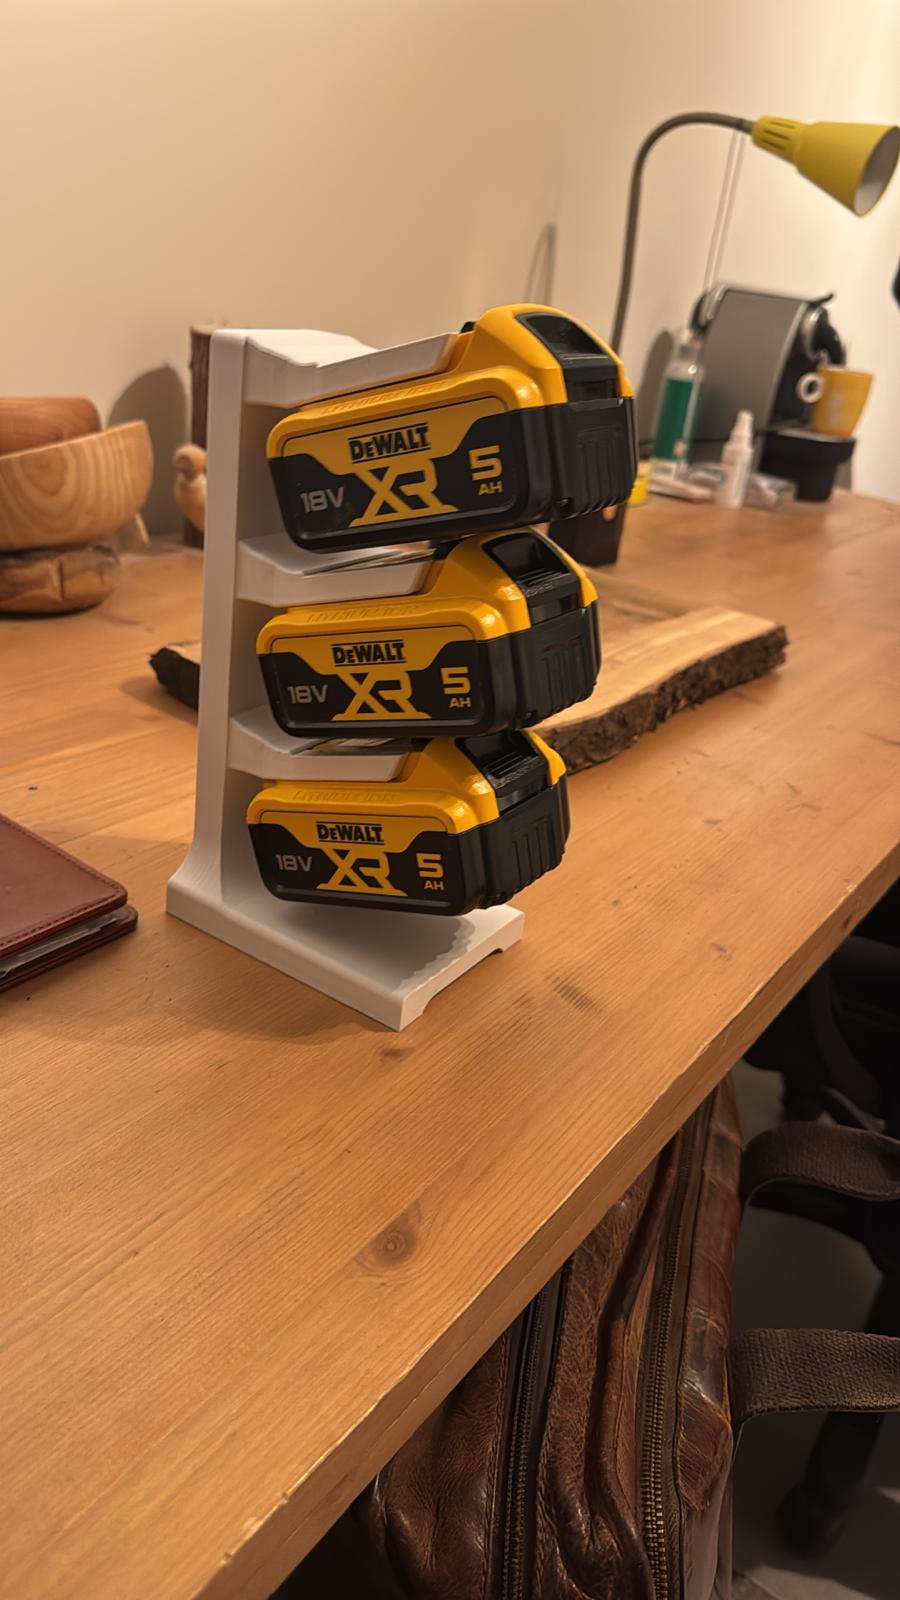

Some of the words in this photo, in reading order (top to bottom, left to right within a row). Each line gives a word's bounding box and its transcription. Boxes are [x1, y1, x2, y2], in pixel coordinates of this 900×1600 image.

[468, 445, 502, 481] 5
[300, 486, 345, 513] 18V
[348, 460, 459, 528] XR
[478, 480, 503, 497] AH
[440, 666, 471, 695] 5
[287, 684, 328, 704] 18V
[330, 671, 432, 721] XR
[449, 697, 471, 708] AH
[275, 854, 312, 872] 18V
[315, 848, 408, 897] XR
[416, 853, 444, 878] 5
[424, 880, 444, 890] AH
